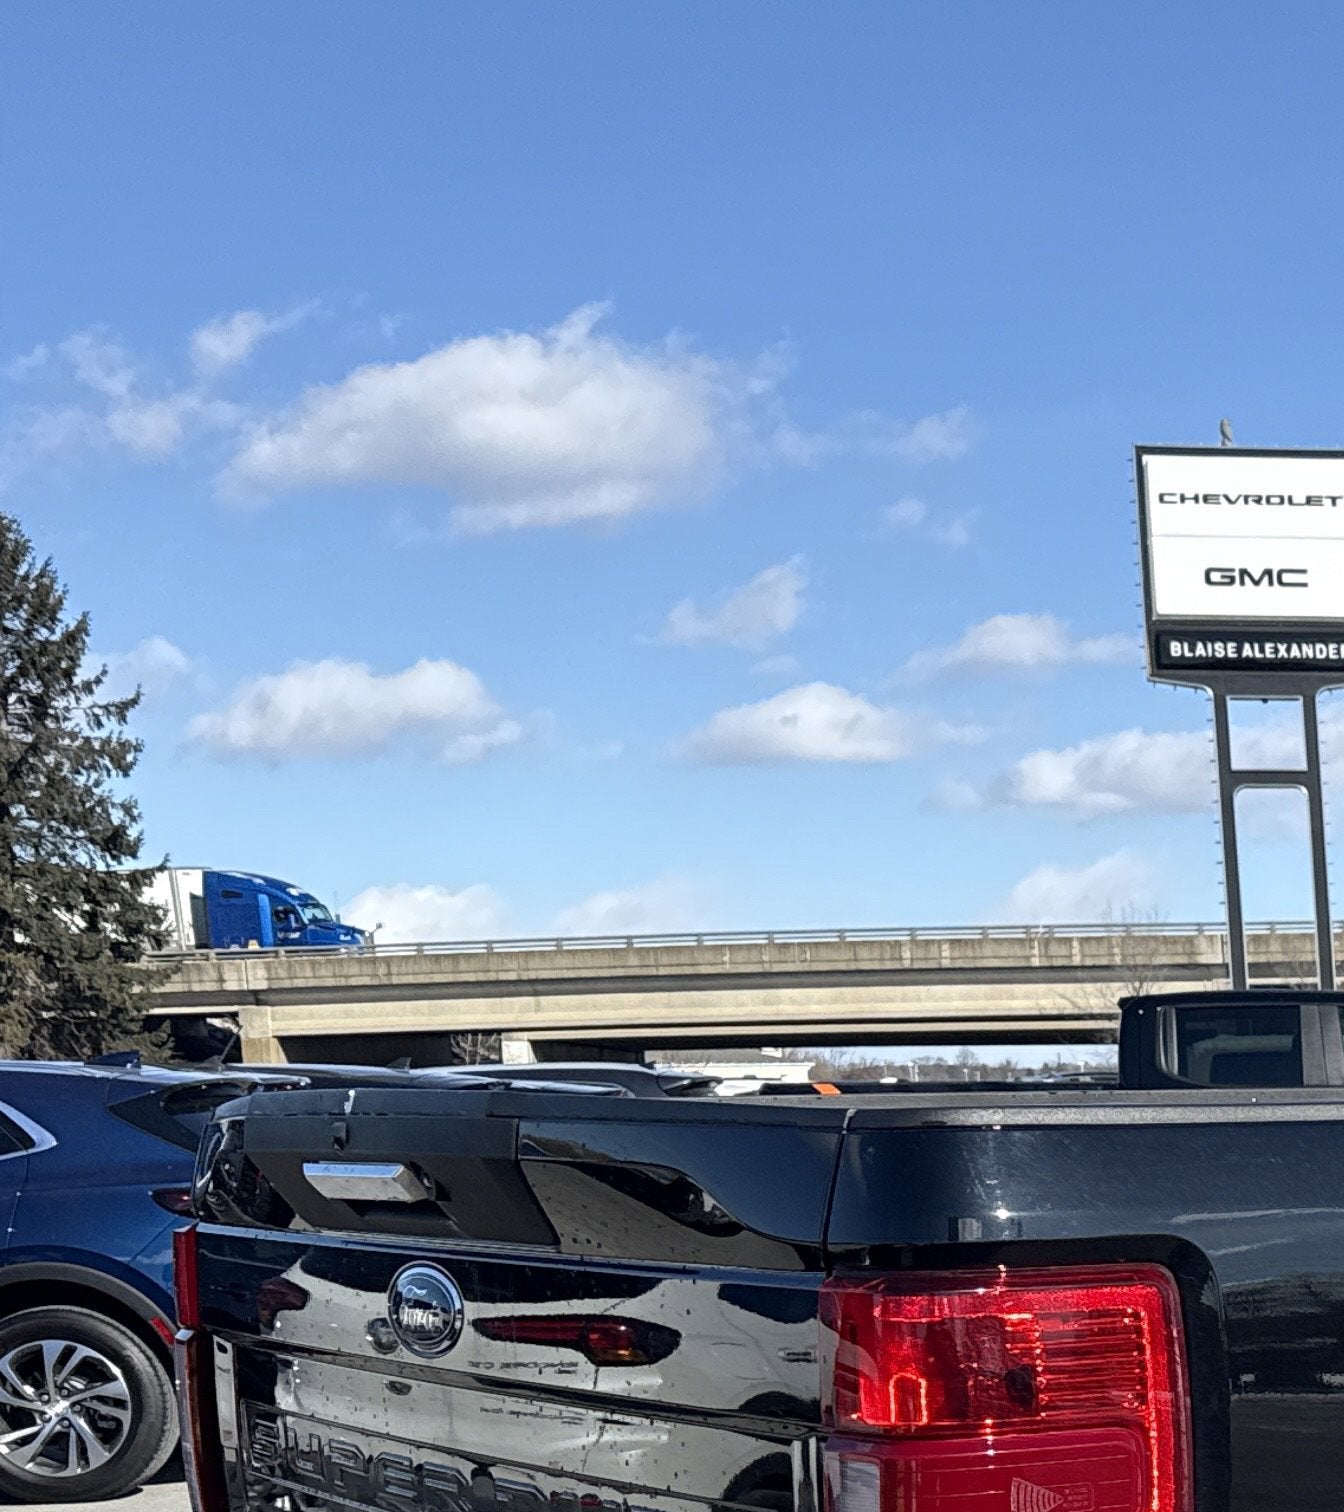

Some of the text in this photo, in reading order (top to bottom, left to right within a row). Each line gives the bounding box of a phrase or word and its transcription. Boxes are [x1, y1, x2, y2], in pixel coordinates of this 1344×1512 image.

[1157, 492, 1344, 508] CHEVROLET
[1204, 566, 1309, 588] GMC
[1169, 640, 1238, 659] BLAISE
